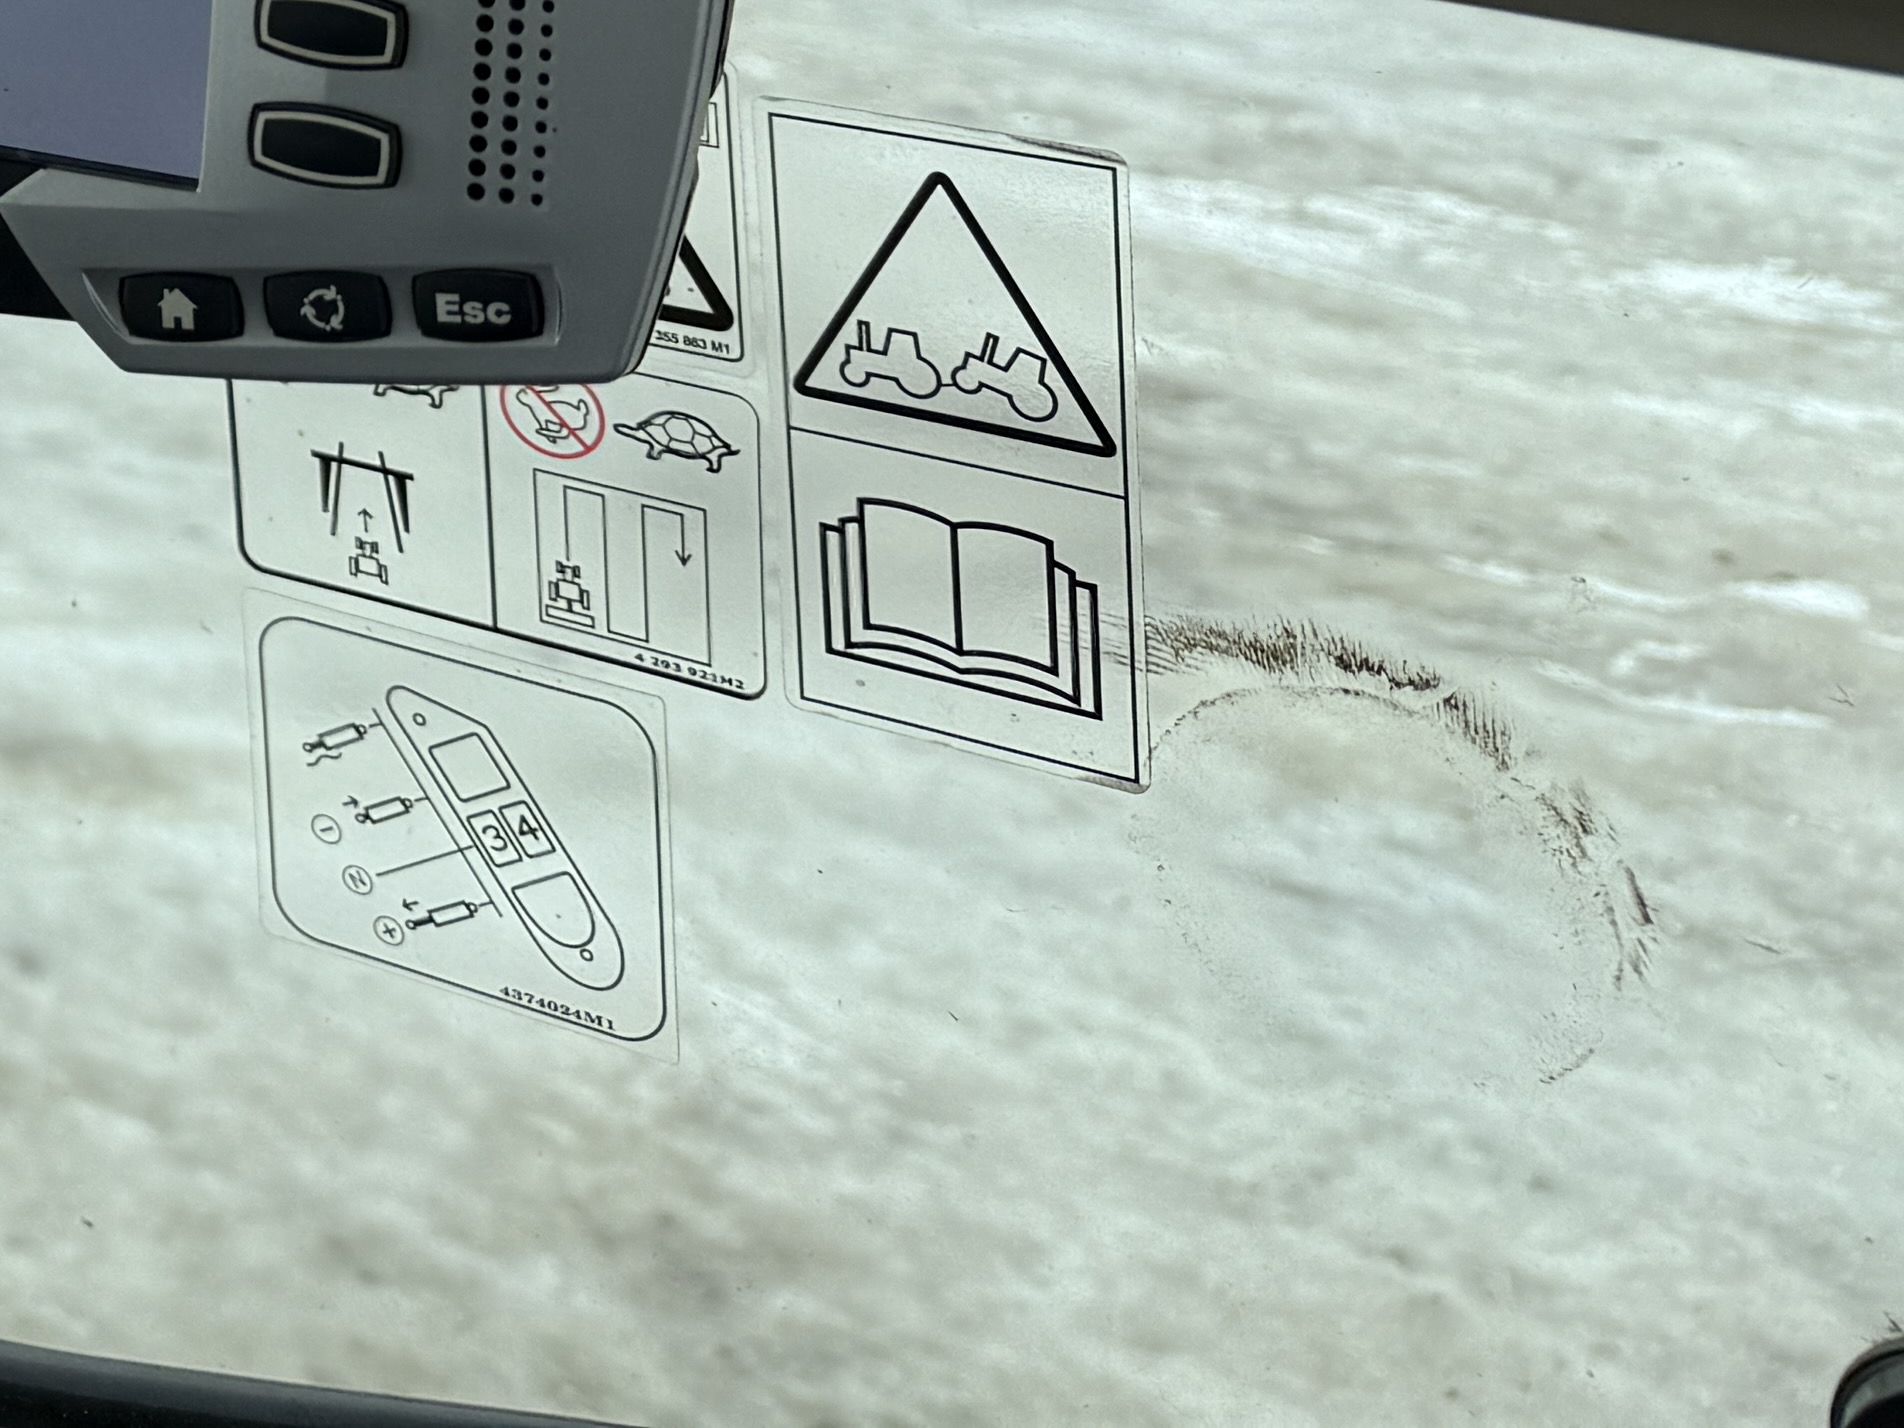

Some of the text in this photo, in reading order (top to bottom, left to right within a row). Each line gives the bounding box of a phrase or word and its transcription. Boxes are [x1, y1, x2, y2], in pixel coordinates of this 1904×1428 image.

[434, 292, 512, 325] Esc
[481, 813, 541, 852] 3 4
